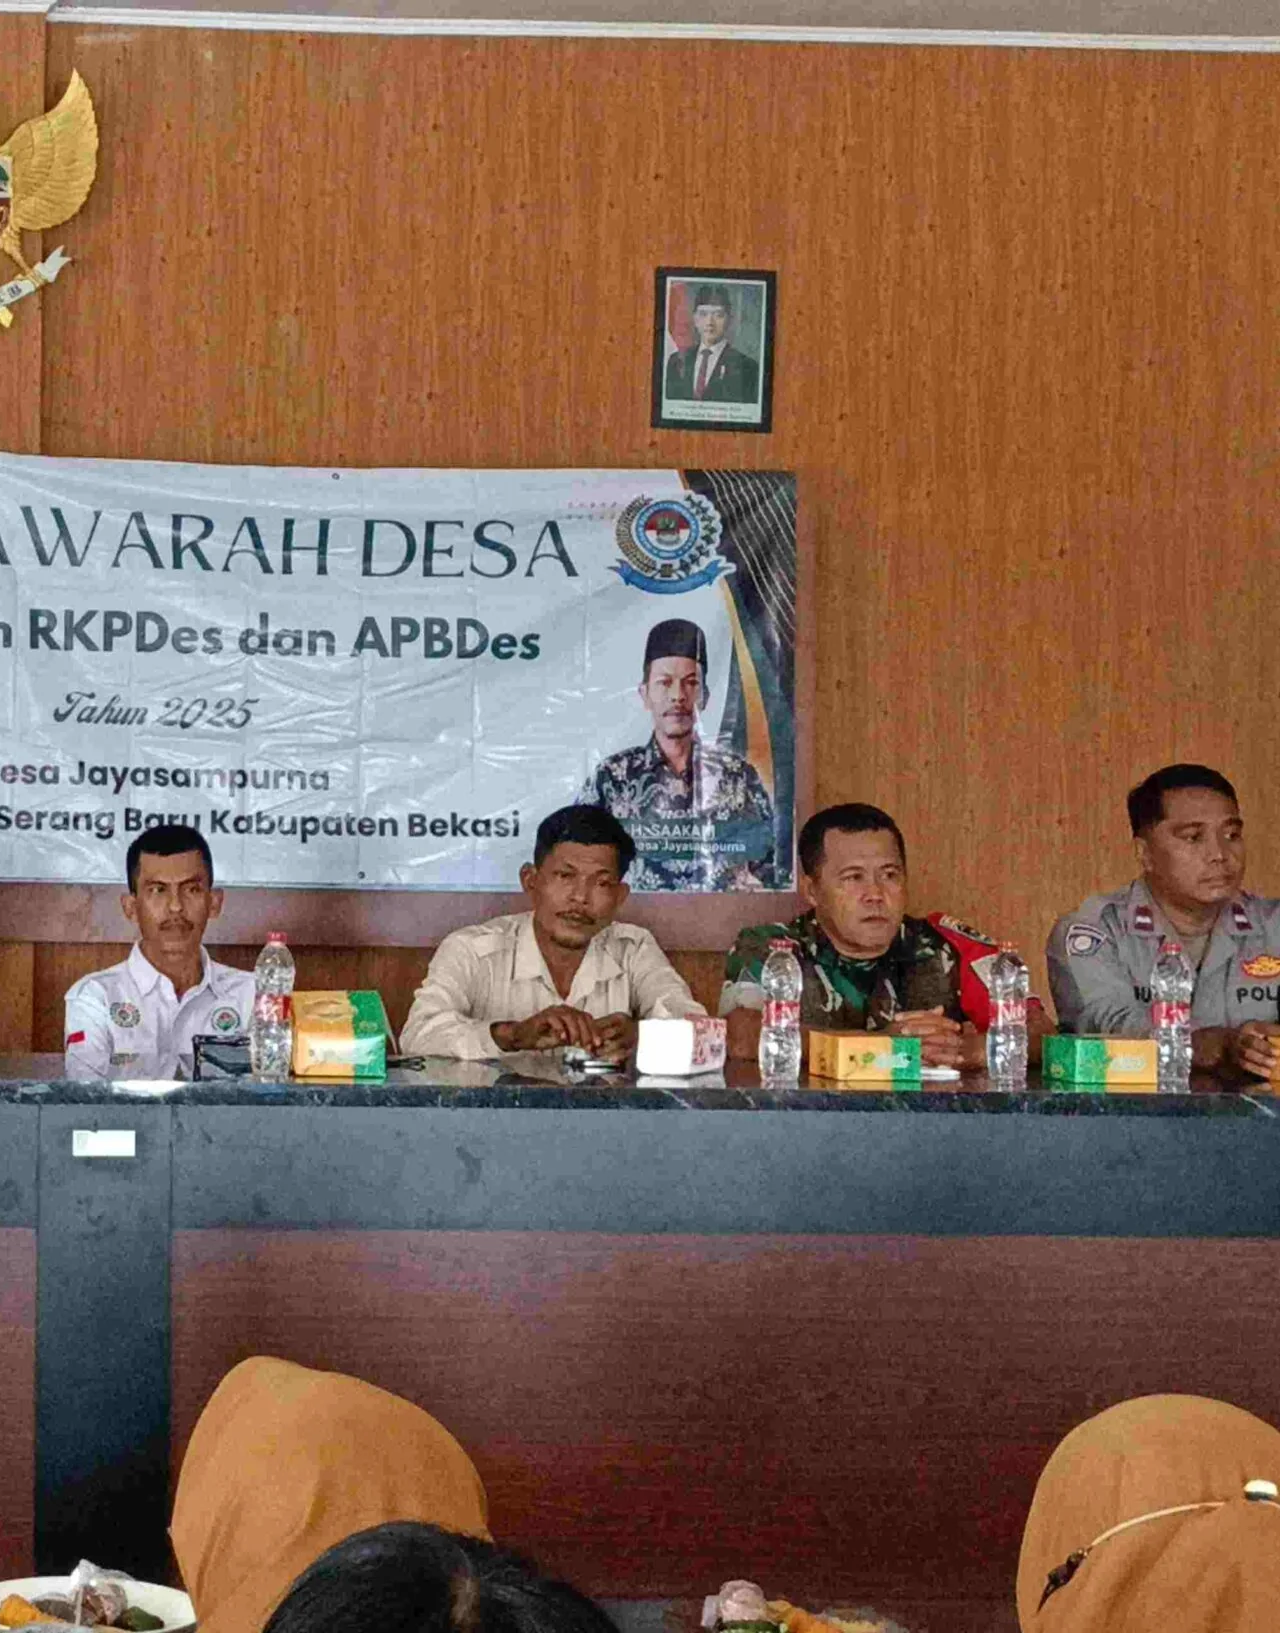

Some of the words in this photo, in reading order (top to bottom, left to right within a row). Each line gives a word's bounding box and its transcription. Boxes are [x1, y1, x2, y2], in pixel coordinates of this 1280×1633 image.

[361, 518, 580, 579] DESA
[28, 608, 222, 656] RKPDes
[238, 612, 337, 658] dan
[351, 616, 541, 661] APBDes
[52, 690, 149, 726] Tahun
[154, 696, 261, 730] 2025
[67, 760, 331, 798] Jayasampurna
[210, 808, 399, 845] Kabupaten
[408, 810, 521, 839] Bekasi
